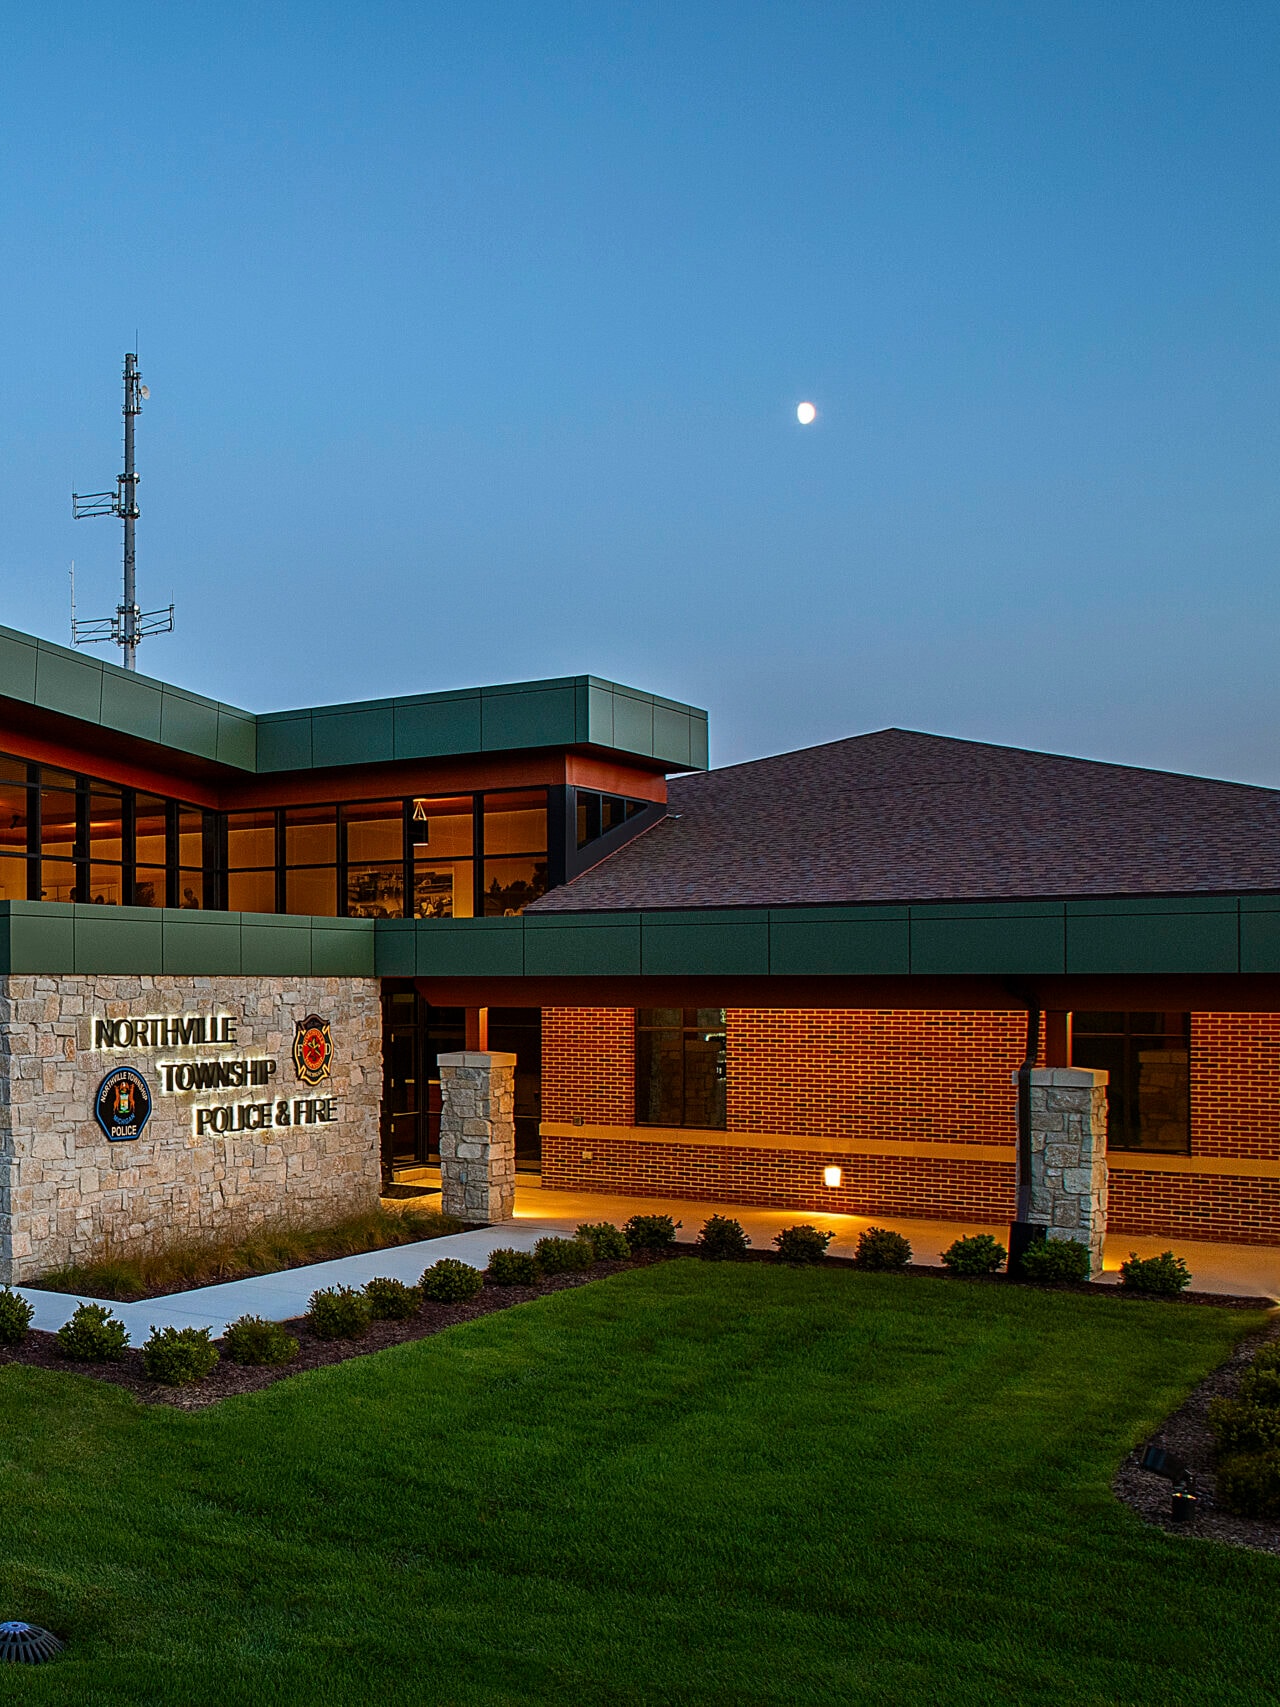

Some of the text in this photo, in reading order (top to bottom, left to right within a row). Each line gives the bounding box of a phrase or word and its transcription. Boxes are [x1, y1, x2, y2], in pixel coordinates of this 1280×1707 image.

[95, 1017, 237, 1048] NORTHVILLE
[100, 1071, 148, 1103] NORTHVILLE TOWNSHIP
[161, 1060, 277, 1091] TOWNSHIP
[111, 1125, 137, 1137] POLICE
[196, 1097, 338, 1135] POLICE & FIRE
